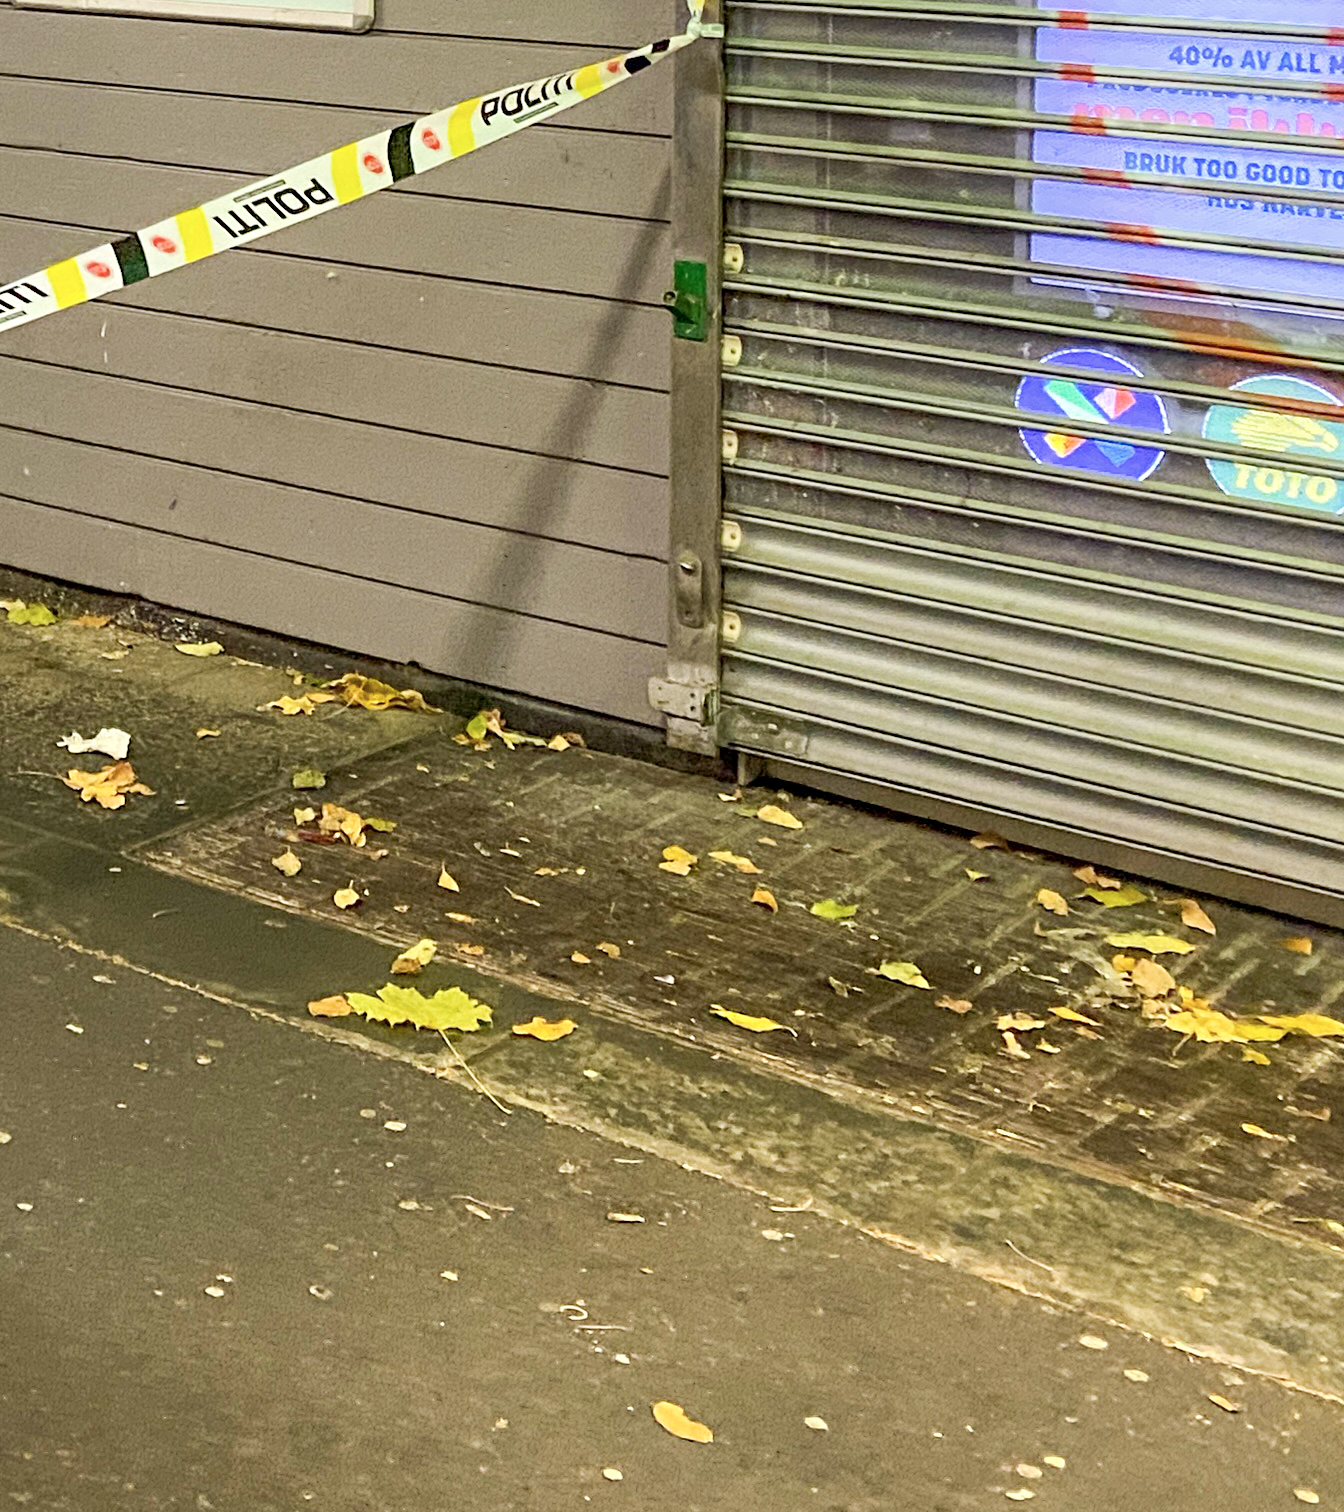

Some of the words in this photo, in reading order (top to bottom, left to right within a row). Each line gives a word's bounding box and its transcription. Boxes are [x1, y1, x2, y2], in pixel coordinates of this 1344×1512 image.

[1168, 44, 1233, 68] 40%
[1240, 50, 1271, 70] AV
[1277, 51, 1321, 73] ALL
[1124, 151, 1188, 175] BRUK
[1193, 157, 1238, 179] TOO
[1246, 162, 1310, 186] GOOD
[213, 178, 335, 238] POLITI
